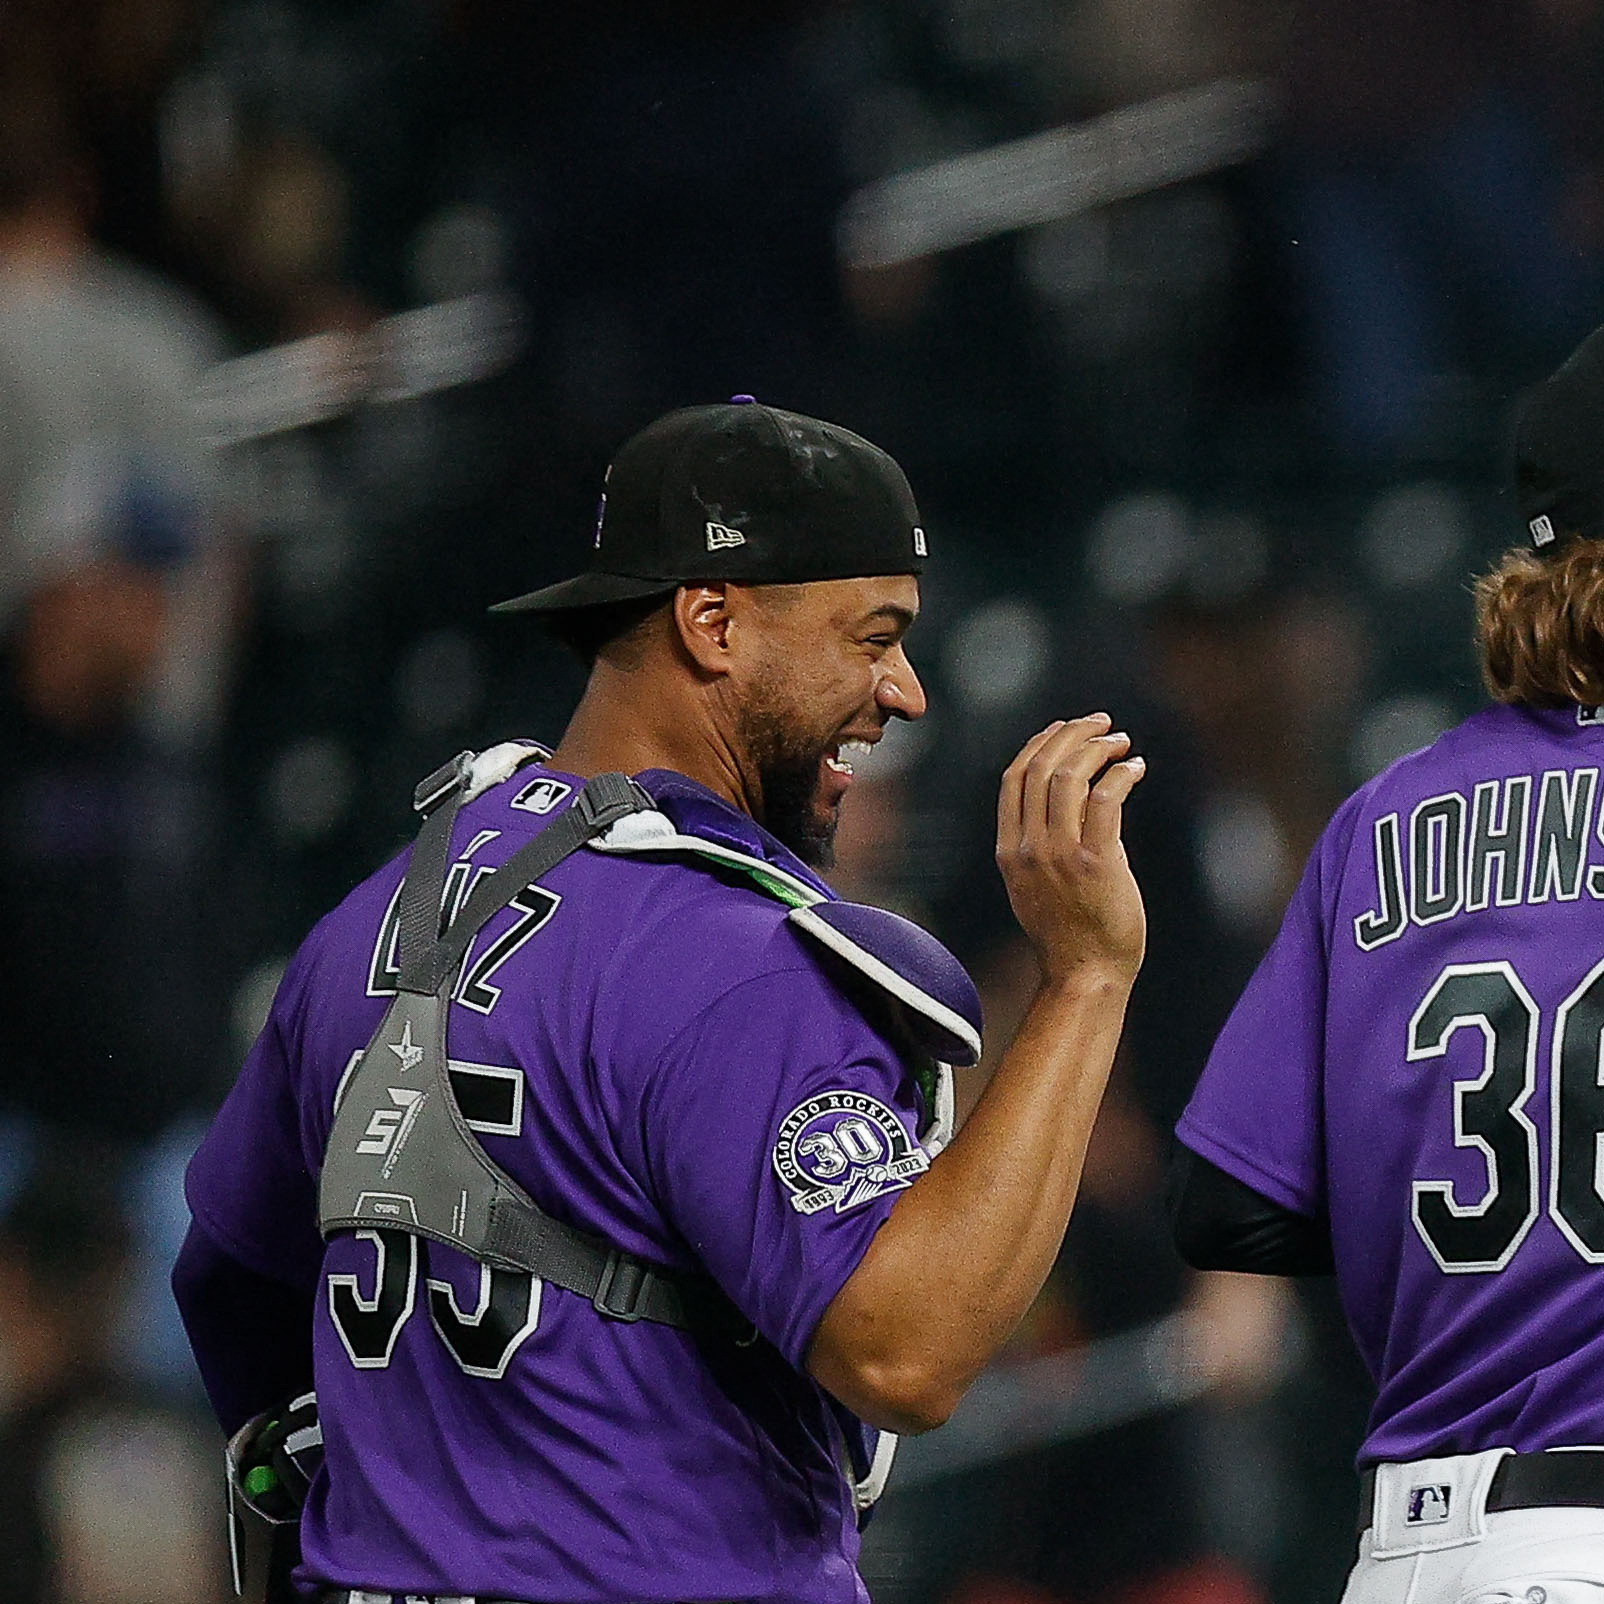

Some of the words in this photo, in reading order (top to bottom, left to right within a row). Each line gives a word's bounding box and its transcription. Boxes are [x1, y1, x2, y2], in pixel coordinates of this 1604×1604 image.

[777, 1102, 820, 1179] COLORADO
[828, 1096, 902, 1139] ROCKIES
[798, 1117, 884, 1179] 30
[893, 1158, 922, 1175] 2023
[804, 1190, 835, 1209] 1993
